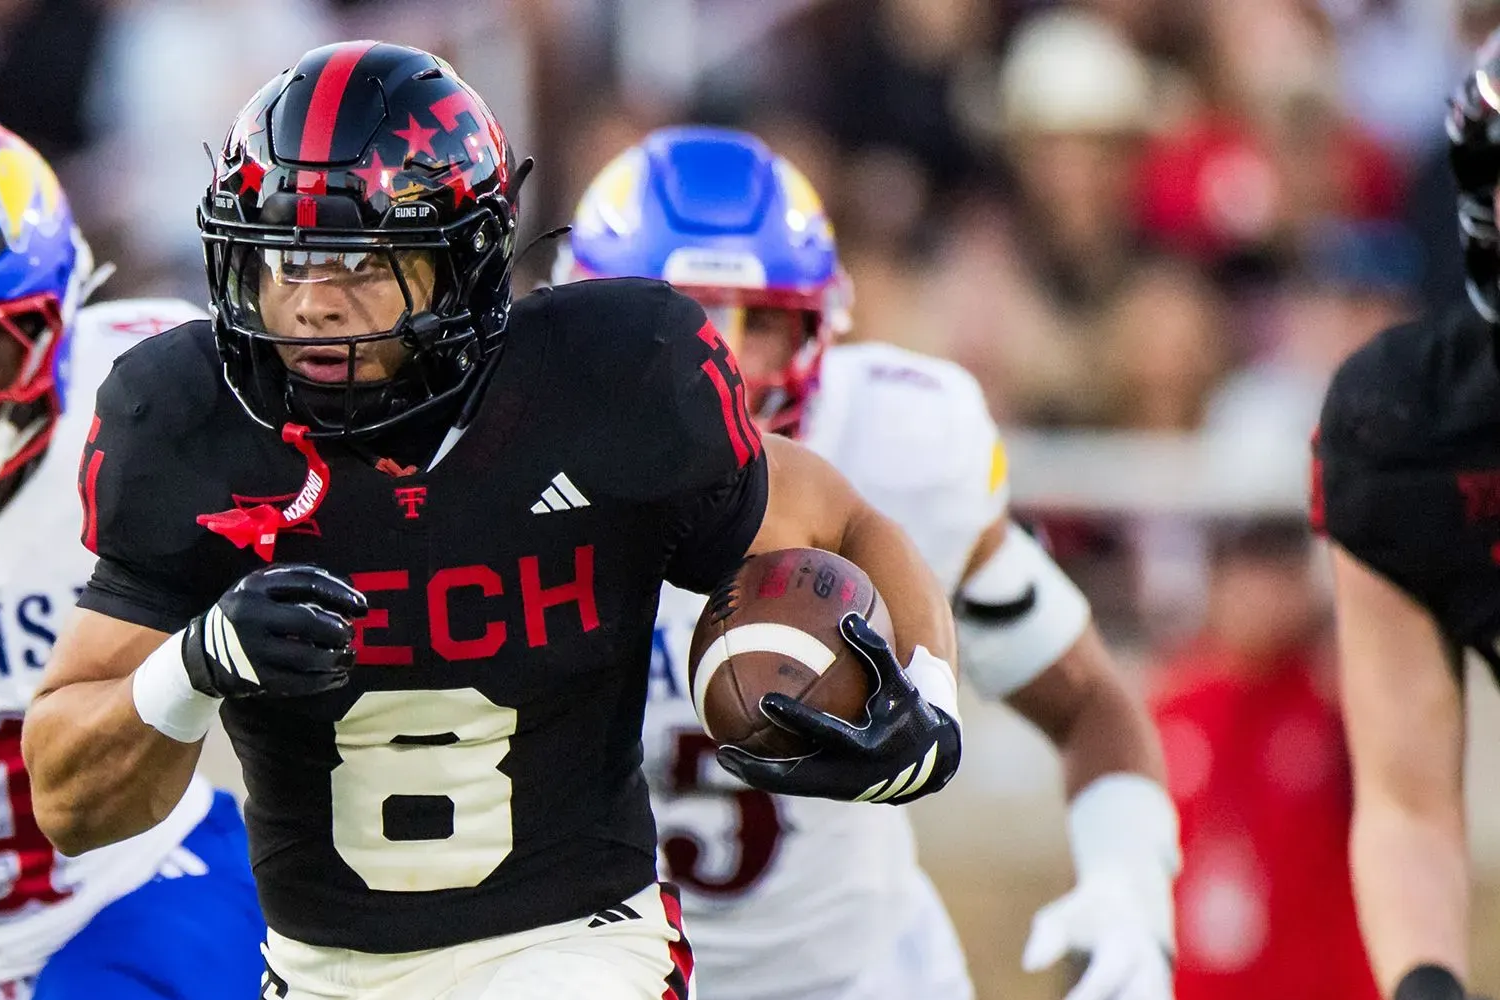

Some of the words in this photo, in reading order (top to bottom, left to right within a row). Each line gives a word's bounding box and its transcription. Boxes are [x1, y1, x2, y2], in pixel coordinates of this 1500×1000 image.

[394, 206, 417, 218] GUNS
[418, 206, 431, 217] UP
[282, 468, 324, 523] NXTRND
[350, 544, 600, 665] ECH
[331, 687, 518, 892] 8
